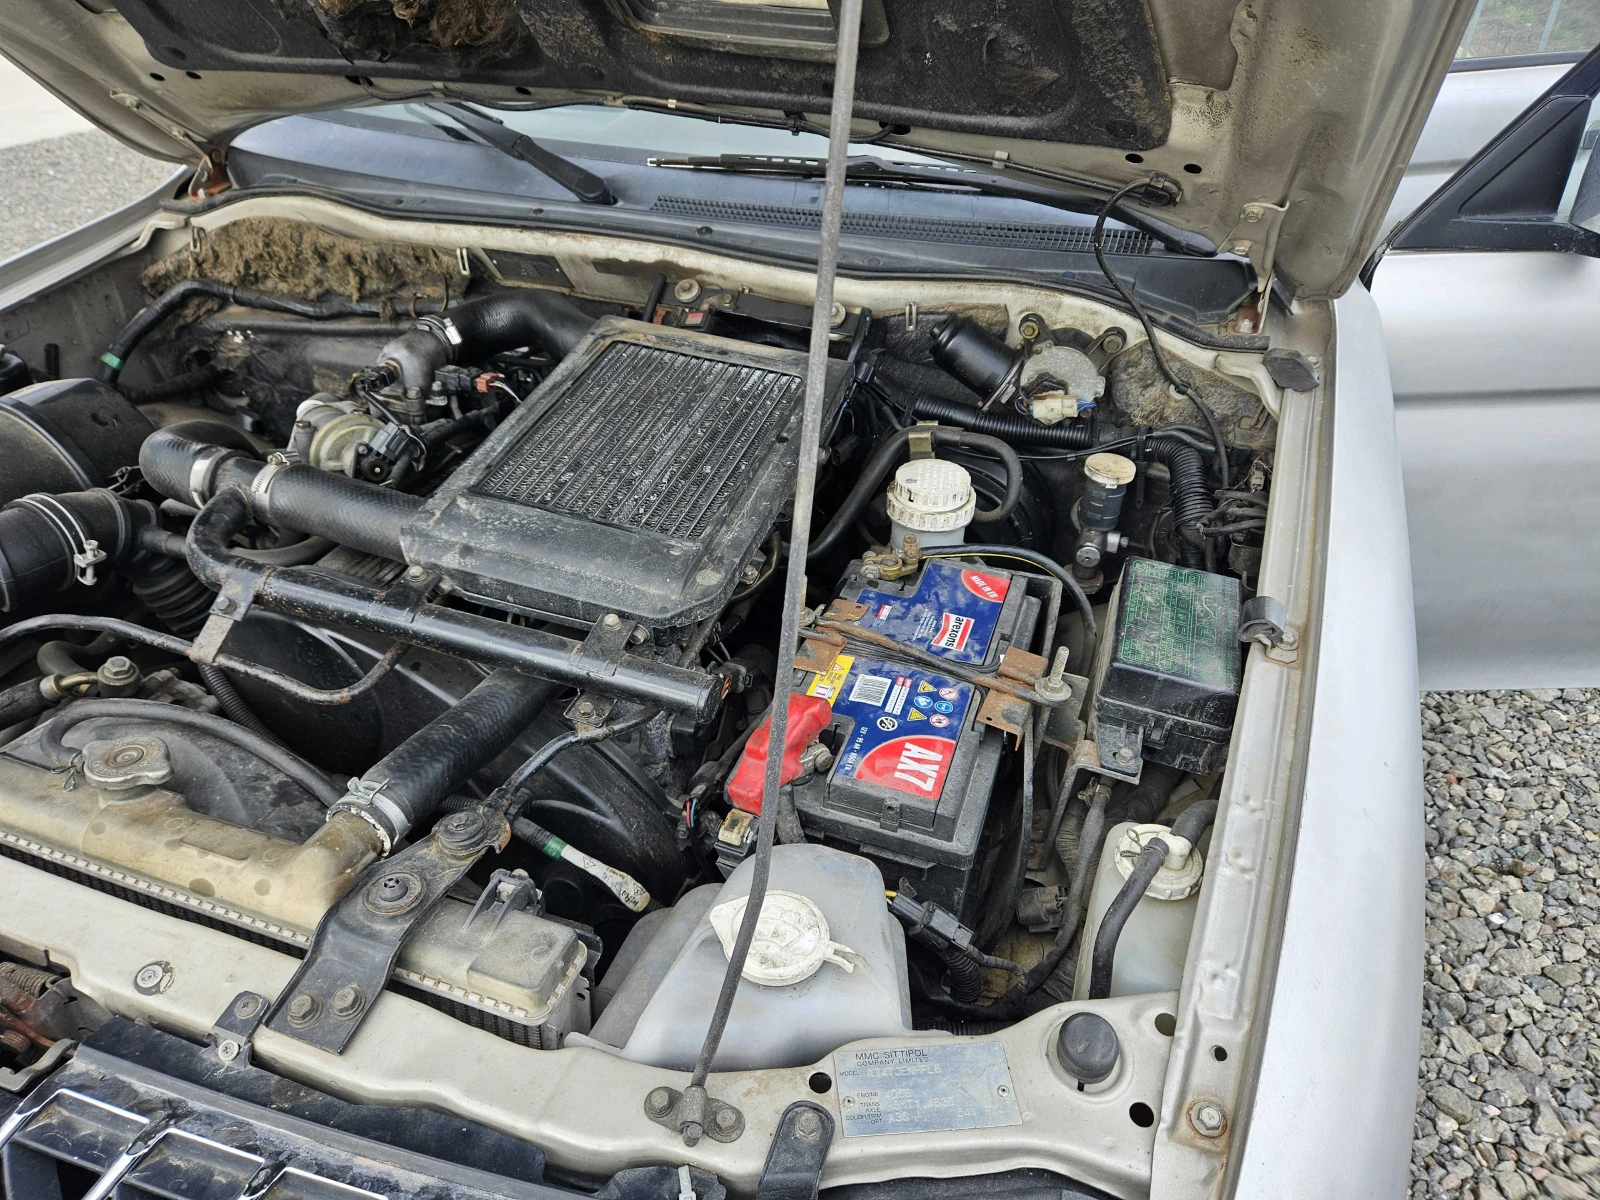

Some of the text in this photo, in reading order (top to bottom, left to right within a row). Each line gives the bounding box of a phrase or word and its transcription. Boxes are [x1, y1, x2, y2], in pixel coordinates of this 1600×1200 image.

[970, 575, 987, 587] MADE
[945, 617, 964, 648] arexons
[894, 742, 944, 792] AX7
[855, 1049, 928, 1061] MMC SITTIPOL
[856, 1056, 929, 1067] COMPANY LIMITED
